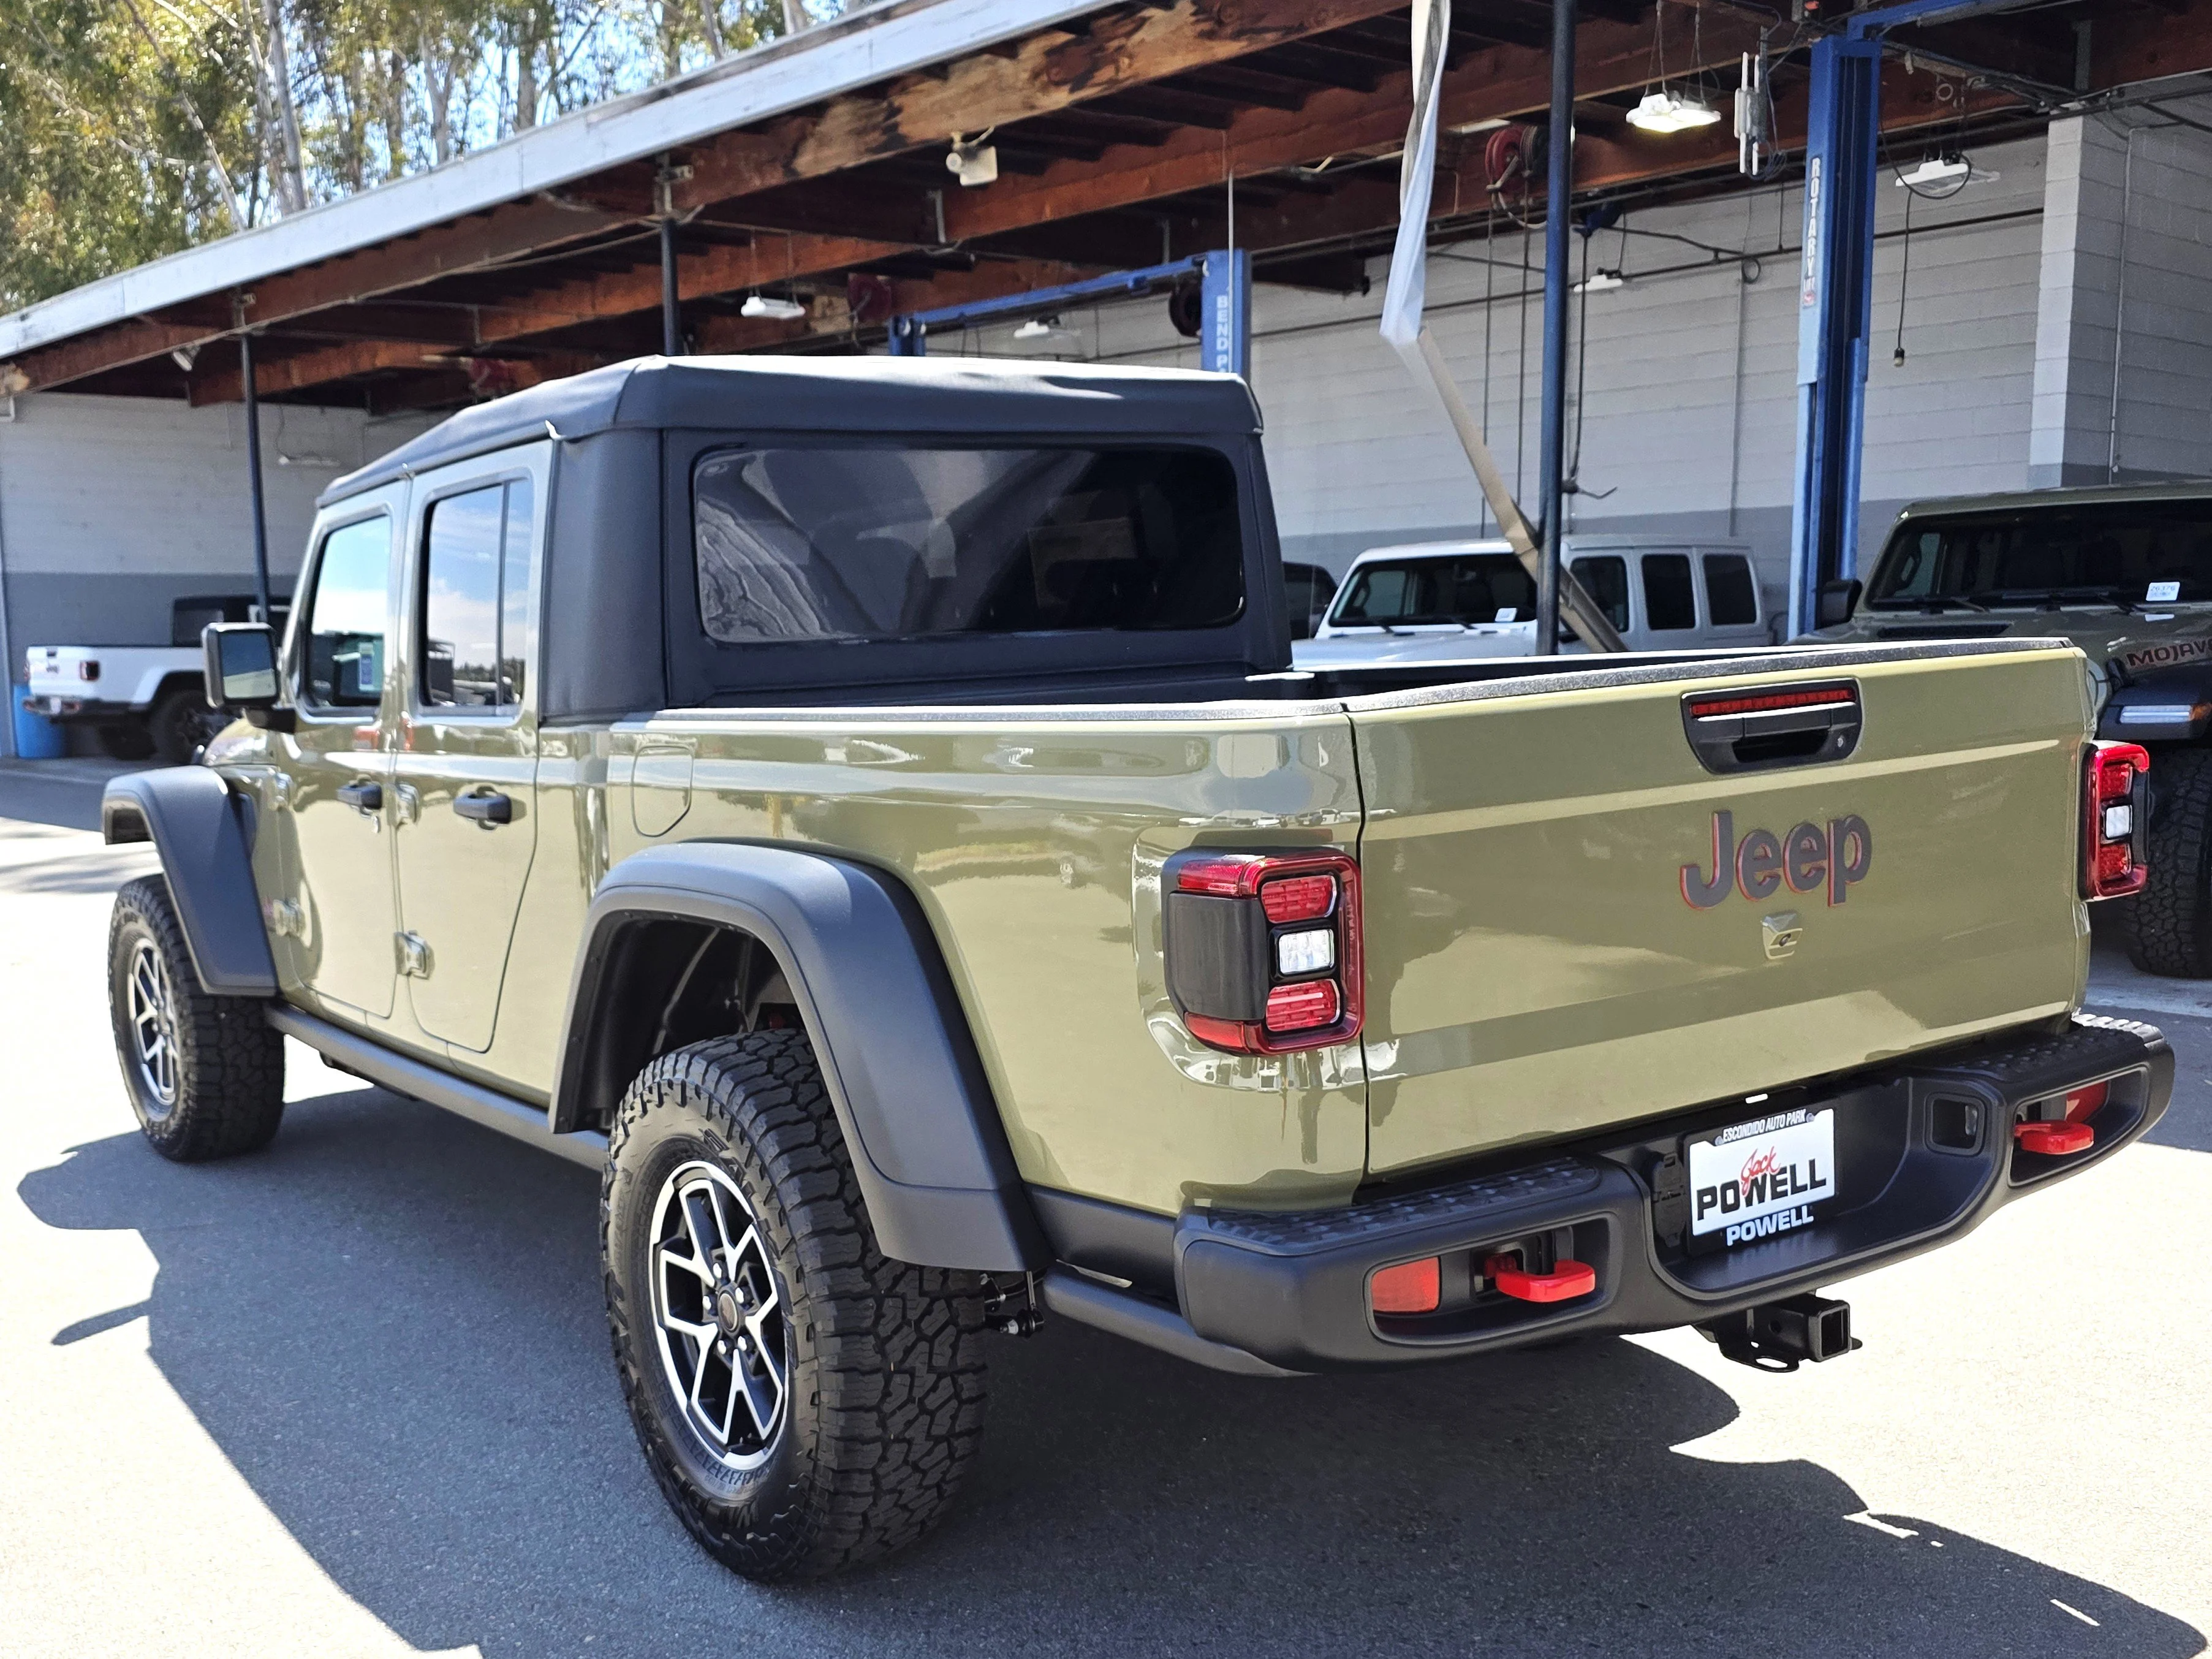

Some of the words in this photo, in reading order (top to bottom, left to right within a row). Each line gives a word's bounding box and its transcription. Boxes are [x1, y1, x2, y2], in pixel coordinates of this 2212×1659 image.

[1807, 157, 1821, 276] ROTARY
[1216, 295, 1229, 372] BENDP
[1679, 809, 1873, 910] Jeep
[1722, 1119, 1766, 1142] ESCONDIDO
[1765, 1114, 1786, 1132] AUTO
[1786, 1108, 1807, 1126] PARK
[1696, 1158, 1827, 1221] POWELL
[1740, 1145, 1781, 1196] Jack
[1726, 1205, 1814, 1247] POWELL
